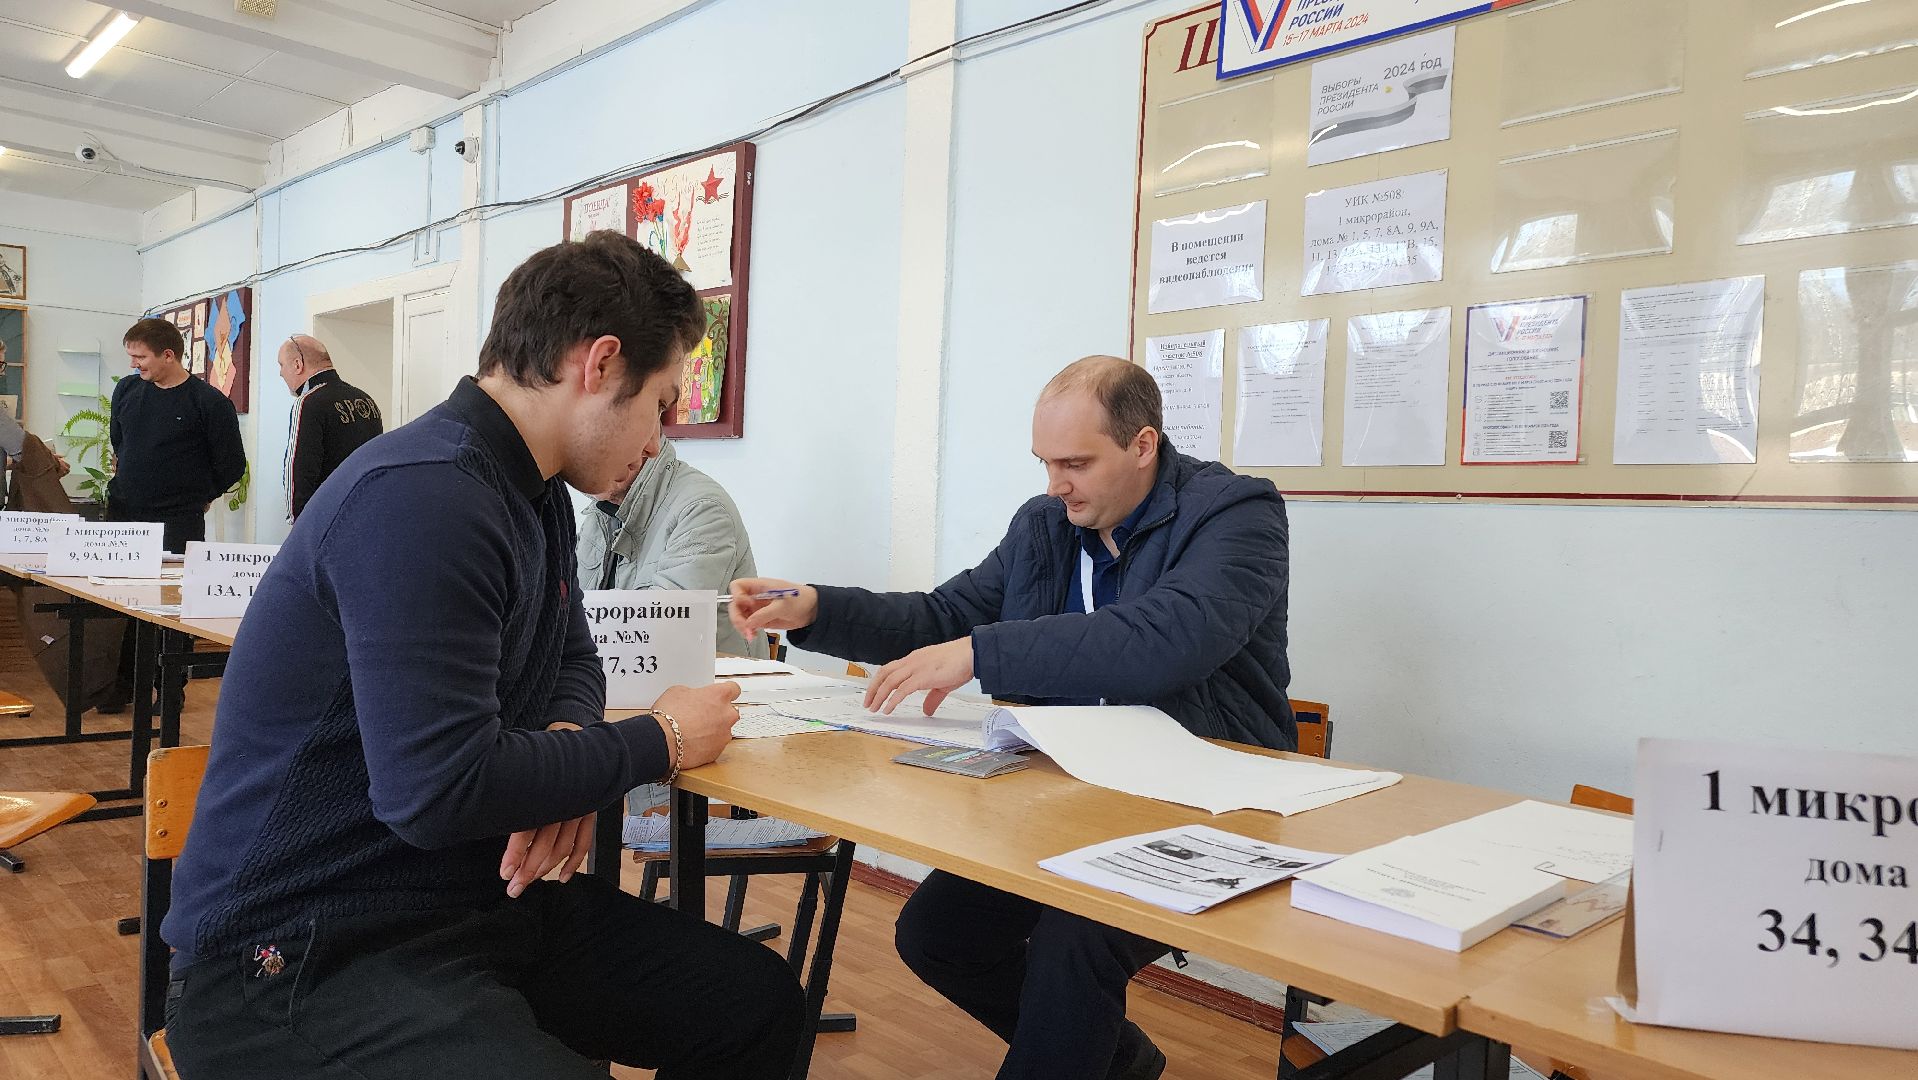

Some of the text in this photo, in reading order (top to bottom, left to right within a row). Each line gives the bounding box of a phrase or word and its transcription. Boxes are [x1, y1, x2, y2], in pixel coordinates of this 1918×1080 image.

[1288, 3, 1345, 30] РОССИИ
[1309, 20, 1344, 40] МАРТА
[1344, 13, 1369, 30] 2024
[1383, 57, 1442, 80] 2024 ГОД
[1319, 83, 1379, 105] ПРЕЗИДЕНТА
[1321, 77, 1362, 94] ВЫБОРЫ
[1317, 100, 1355, 115] РОССИИ
[1345, 195, 1369, 208] УИК
[1171, 233, 1244, 252] В помещении
[334, 398, 381, 424] SPOR
[6, 516, 67, 525] микрора
[65, 526, 150, 539] 1 микрорайон
[69, 552, 80, 562] 9,
[83, 552, 103, 562] 9А,
[128, 552, 141, 562] 13
[205, 550, 275, 566] 1 микро
[207, 584, 242, 598] 13А,
[584, 601, 690, 624] крорайон
[632, 655, 658, 674] 33
[1701, 770, 1727, 812] 1
[1804, 858, 1910, 889] дома
[1756, 908, 1840, 968] 34,
